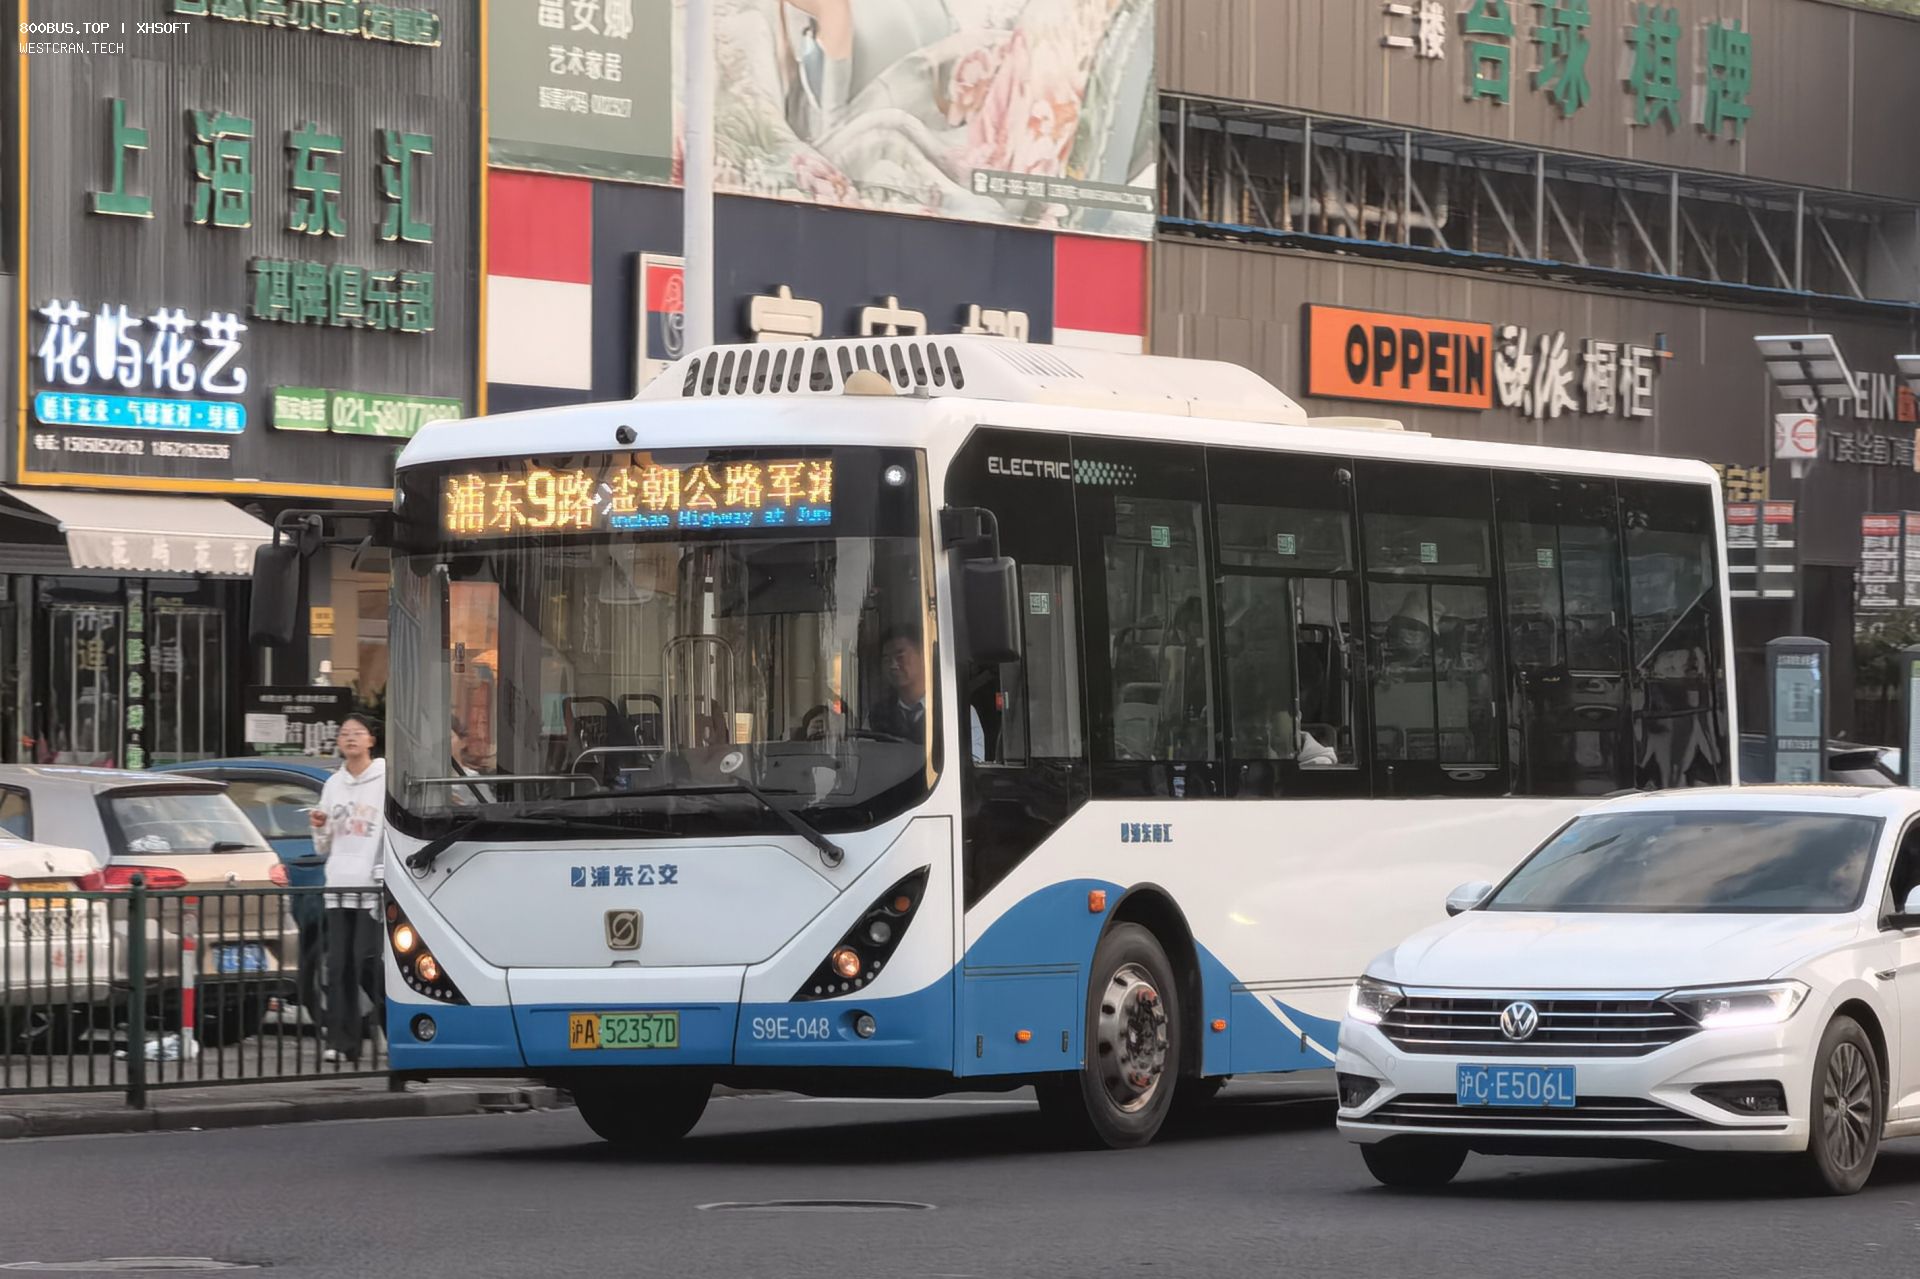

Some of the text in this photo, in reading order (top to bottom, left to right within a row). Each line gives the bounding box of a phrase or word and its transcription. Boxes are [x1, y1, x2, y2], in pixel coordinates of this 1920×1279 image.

[548, 44, 623, 82] 艺术家居
[92, 97, 434, 245] 上海东汇
[38, 299, 248, 395] 花屿花艺
[1345, 323, 1487, 397] OPPEIN
[988, 456, 1071, 480] ELECTRIC
[446, 470, 594, 533] 浦东9路
[678, 508, 753, 528] Highway
[764, 507, 785, 523] at
[591, 863, 678, 888] 浦东公交
[752, 1017, 830, 1041] S9E-048
